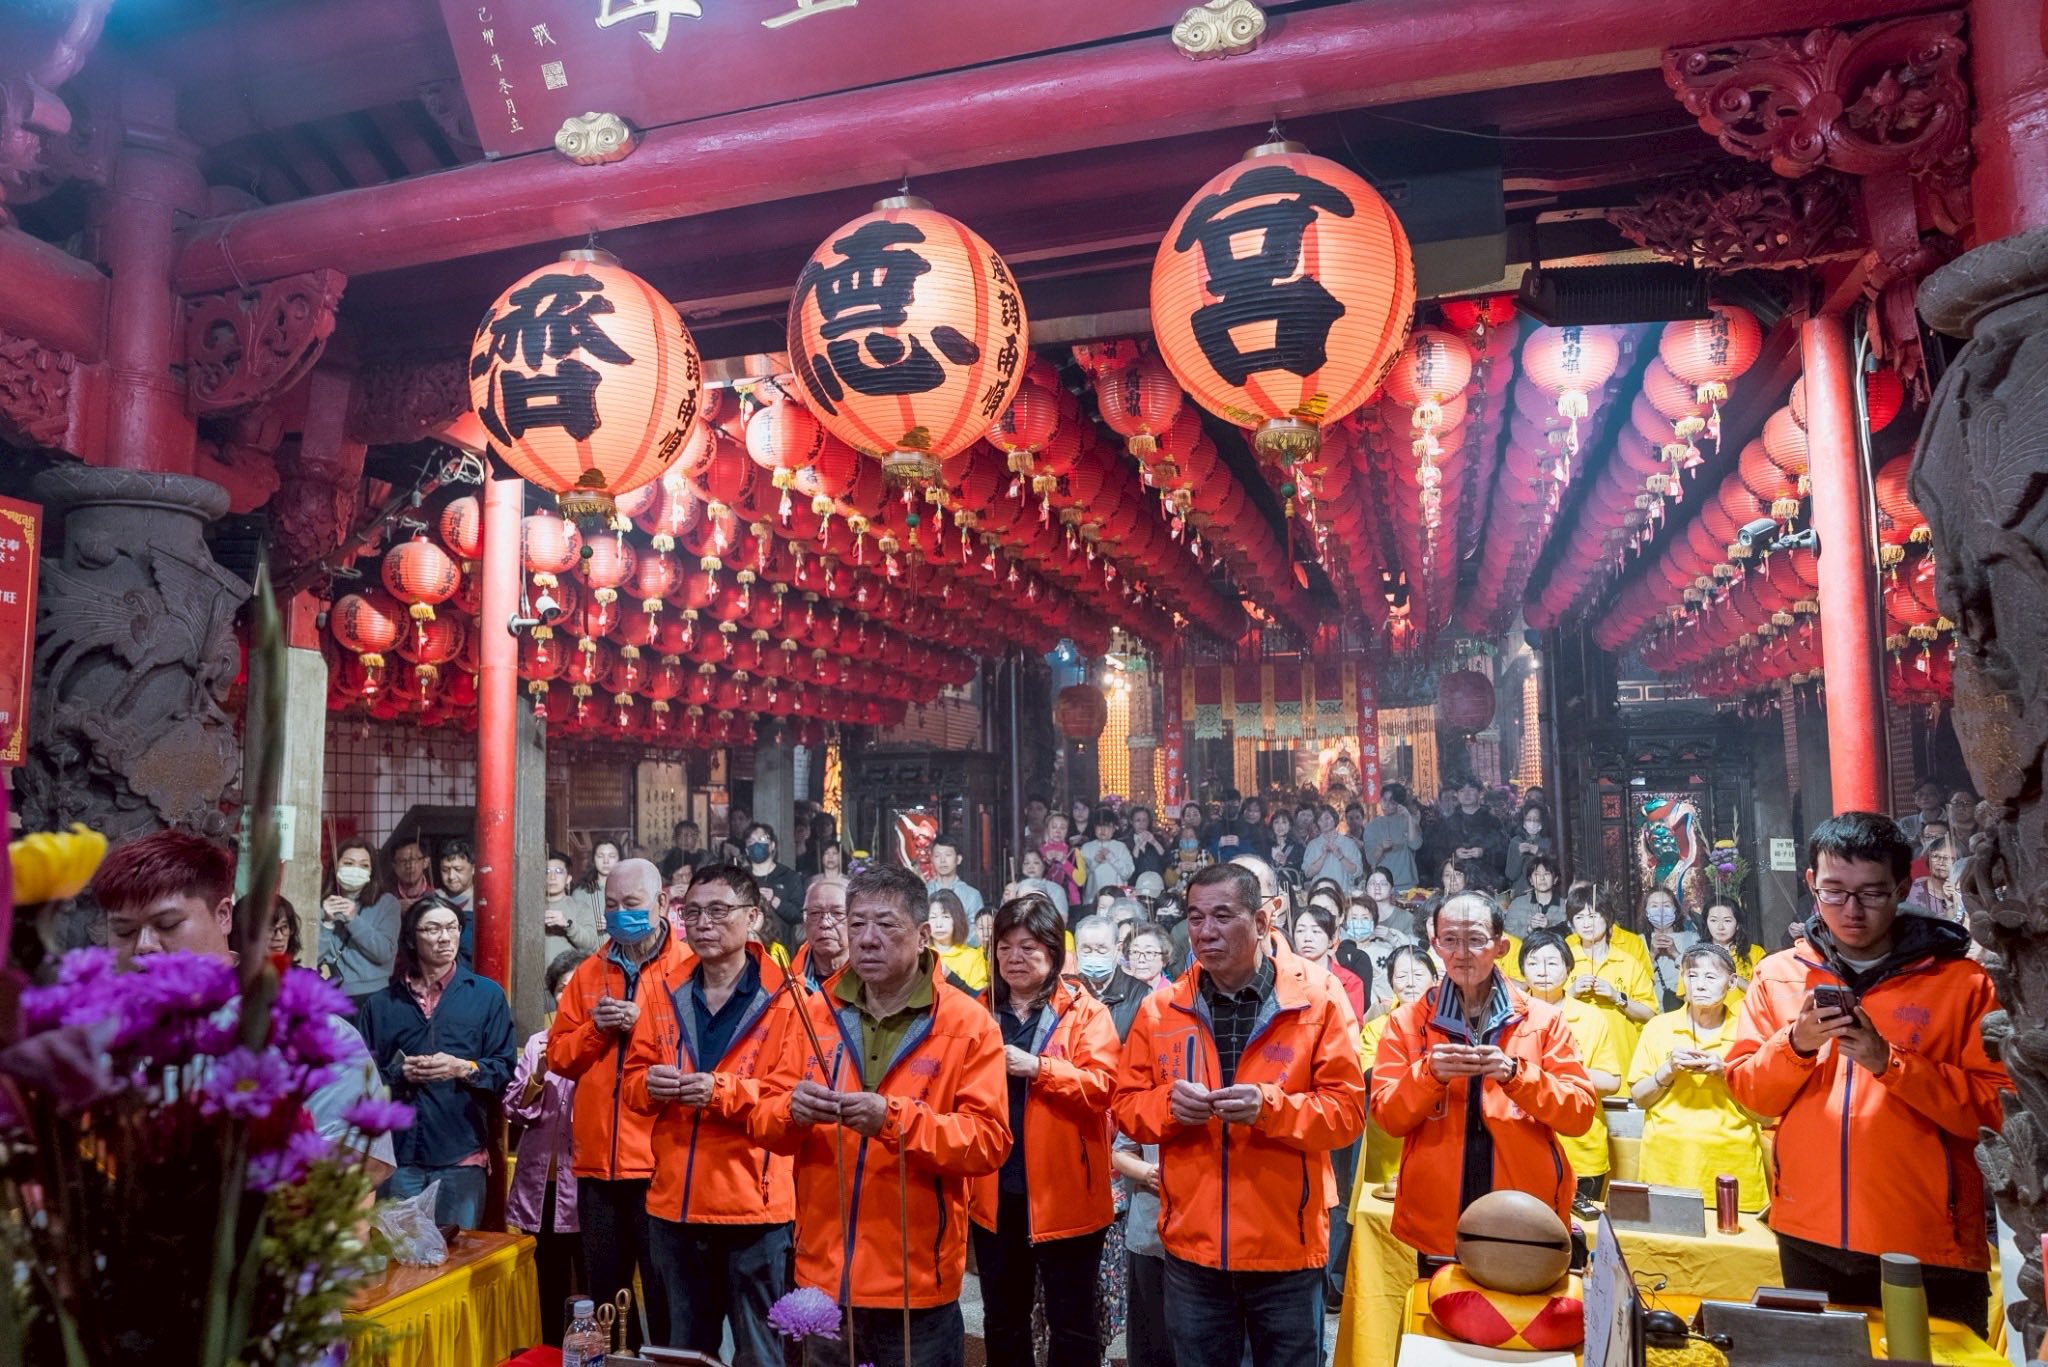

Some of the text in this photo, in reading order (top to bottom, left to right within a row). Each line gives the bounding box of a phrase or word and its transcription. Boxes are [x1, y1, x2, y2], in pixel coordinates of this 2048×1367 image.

[477, 6, 524, 134] 己卯年冬月立
[1174, 165, 1355, 387] 宮
